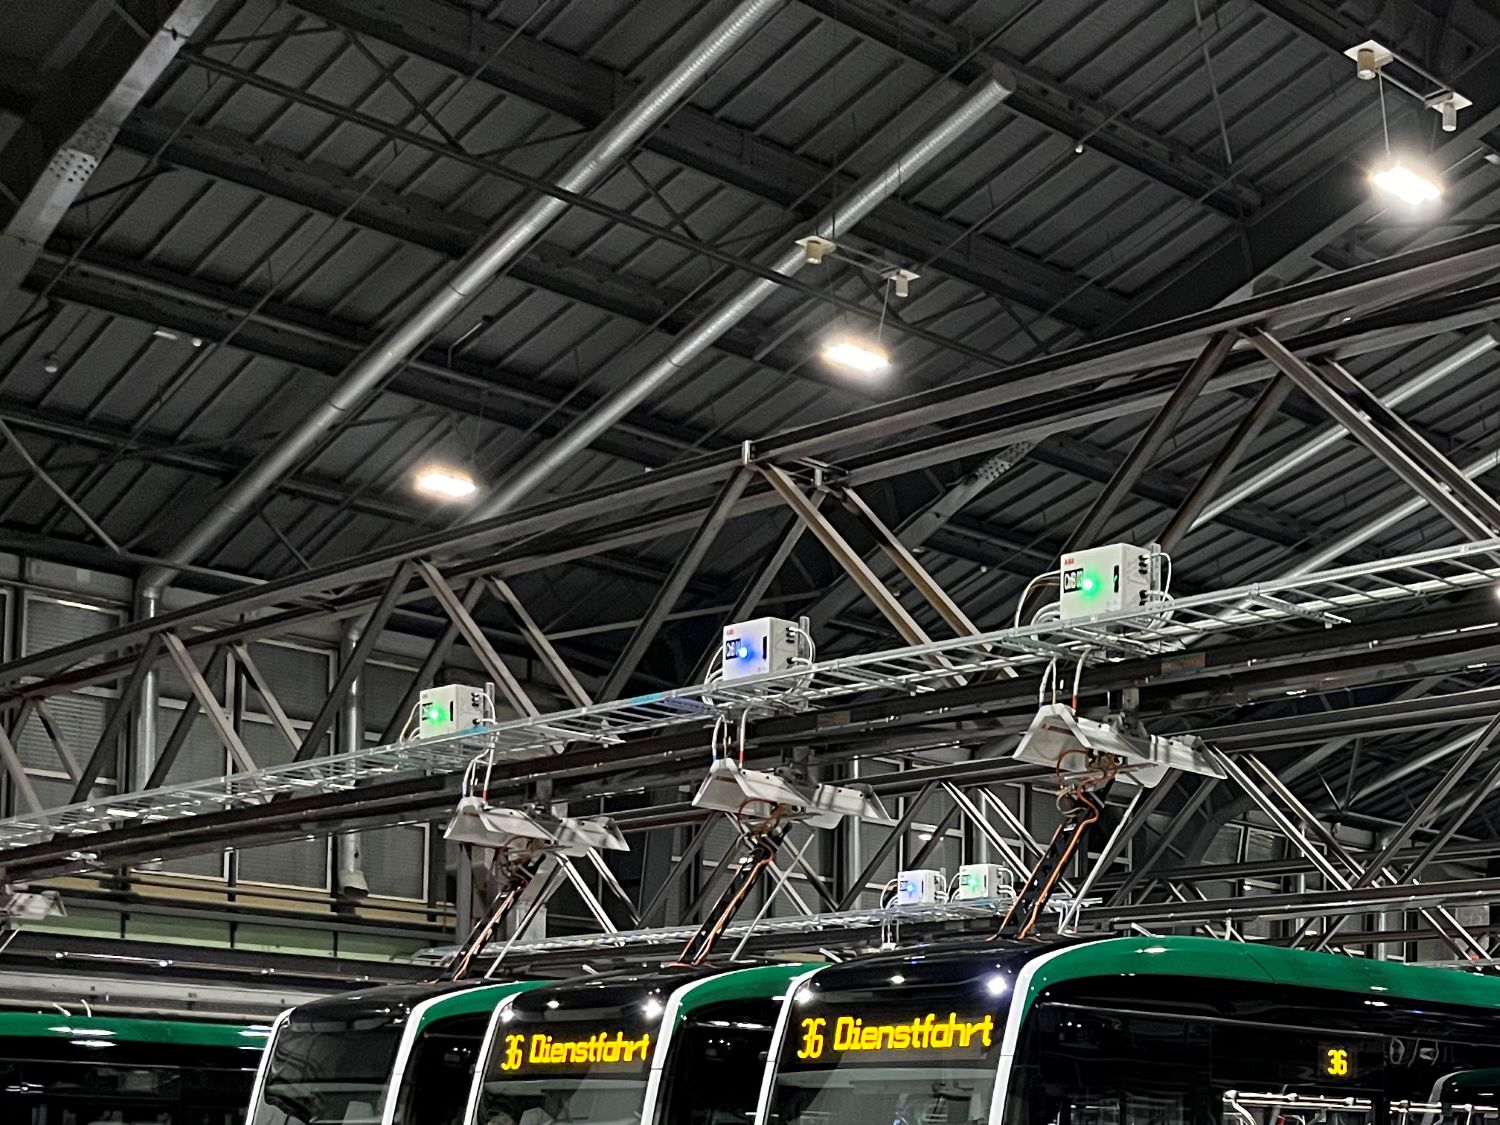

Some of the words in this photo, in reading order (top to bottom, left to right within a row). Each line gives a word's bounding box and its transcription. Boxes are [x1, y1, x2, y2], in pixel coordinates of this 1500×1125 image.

[501, 1034, 525, 1071] 36
[529, 1031, 650, 1064] Dienstfahrt
[797, 1018, 826, 1059] 36
[833, 1012, 994, 1051] Dienstfahrt
[1327, 1049, 1348, 1075] 36
